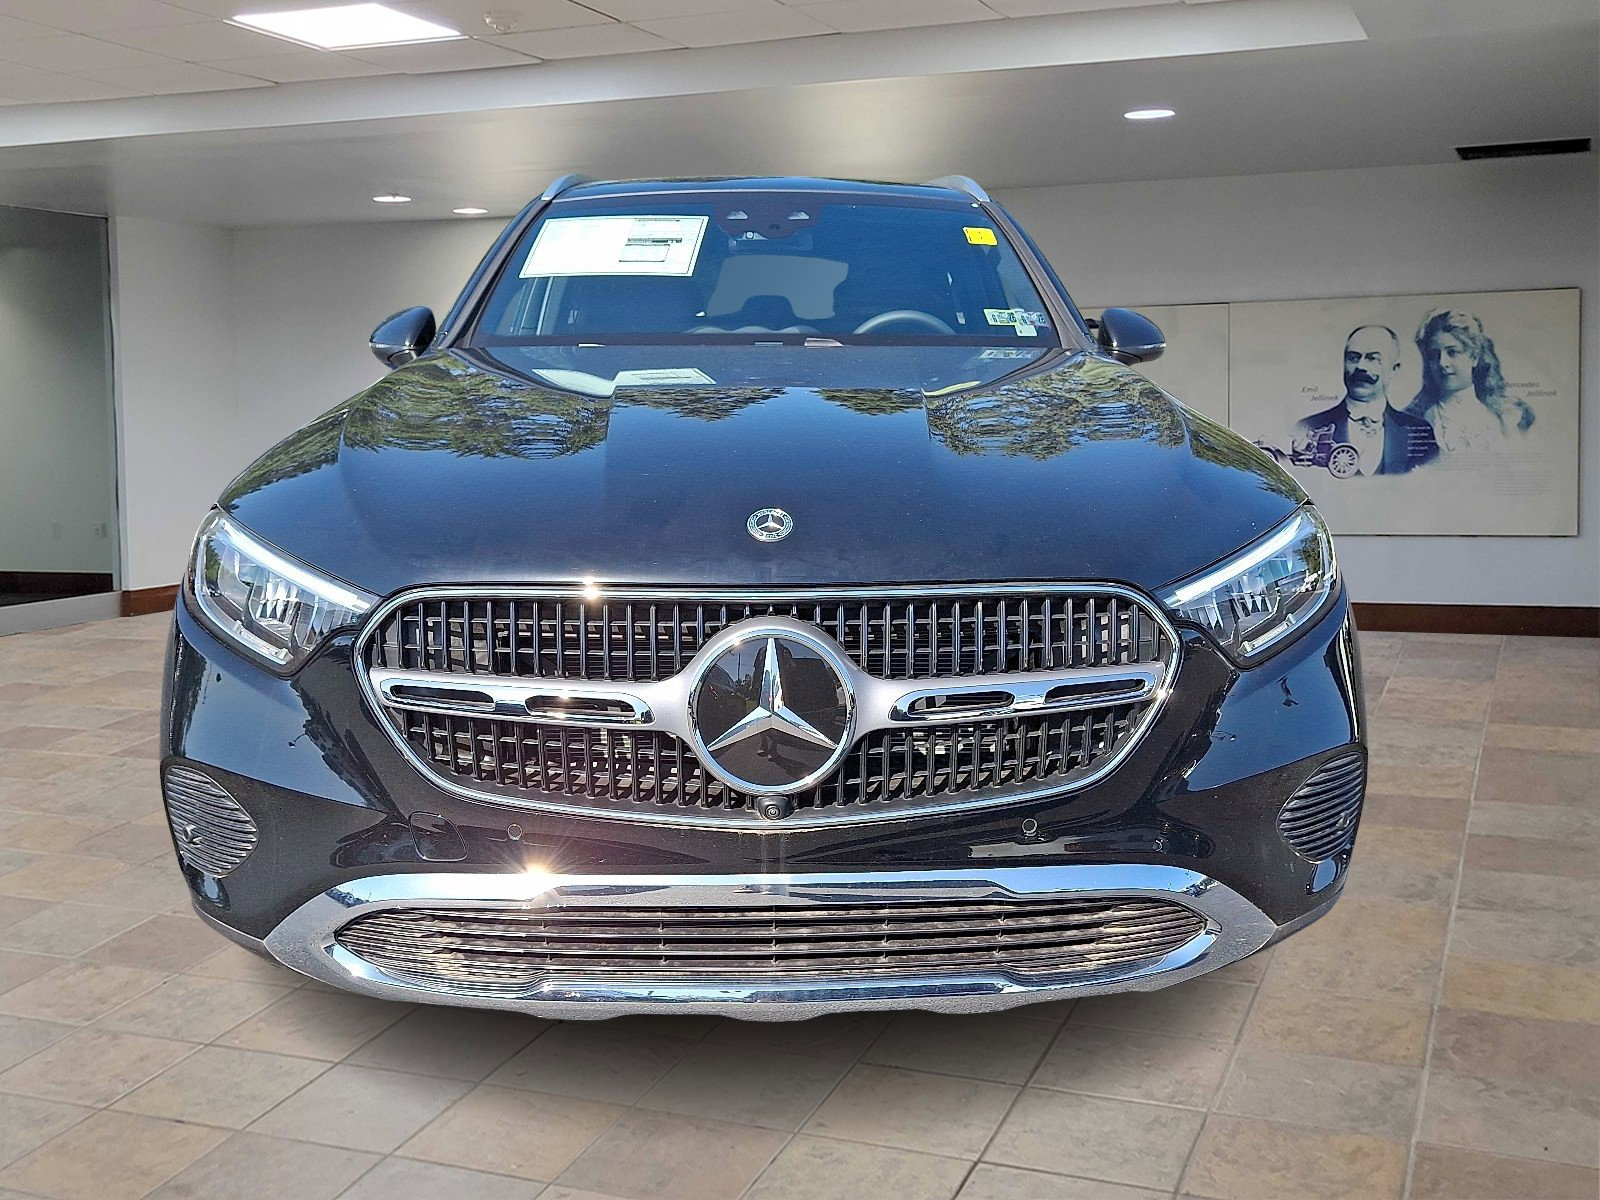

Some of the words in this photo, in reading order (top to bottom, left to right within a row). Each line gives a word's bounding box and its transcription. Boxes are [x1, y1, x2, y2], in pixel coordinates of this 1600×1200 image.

[1301, 385, 1319, 393] Emil
[1526, 389, 1557, 398] Jellinek
[1310, 394, 1339, 402] Jellinek
